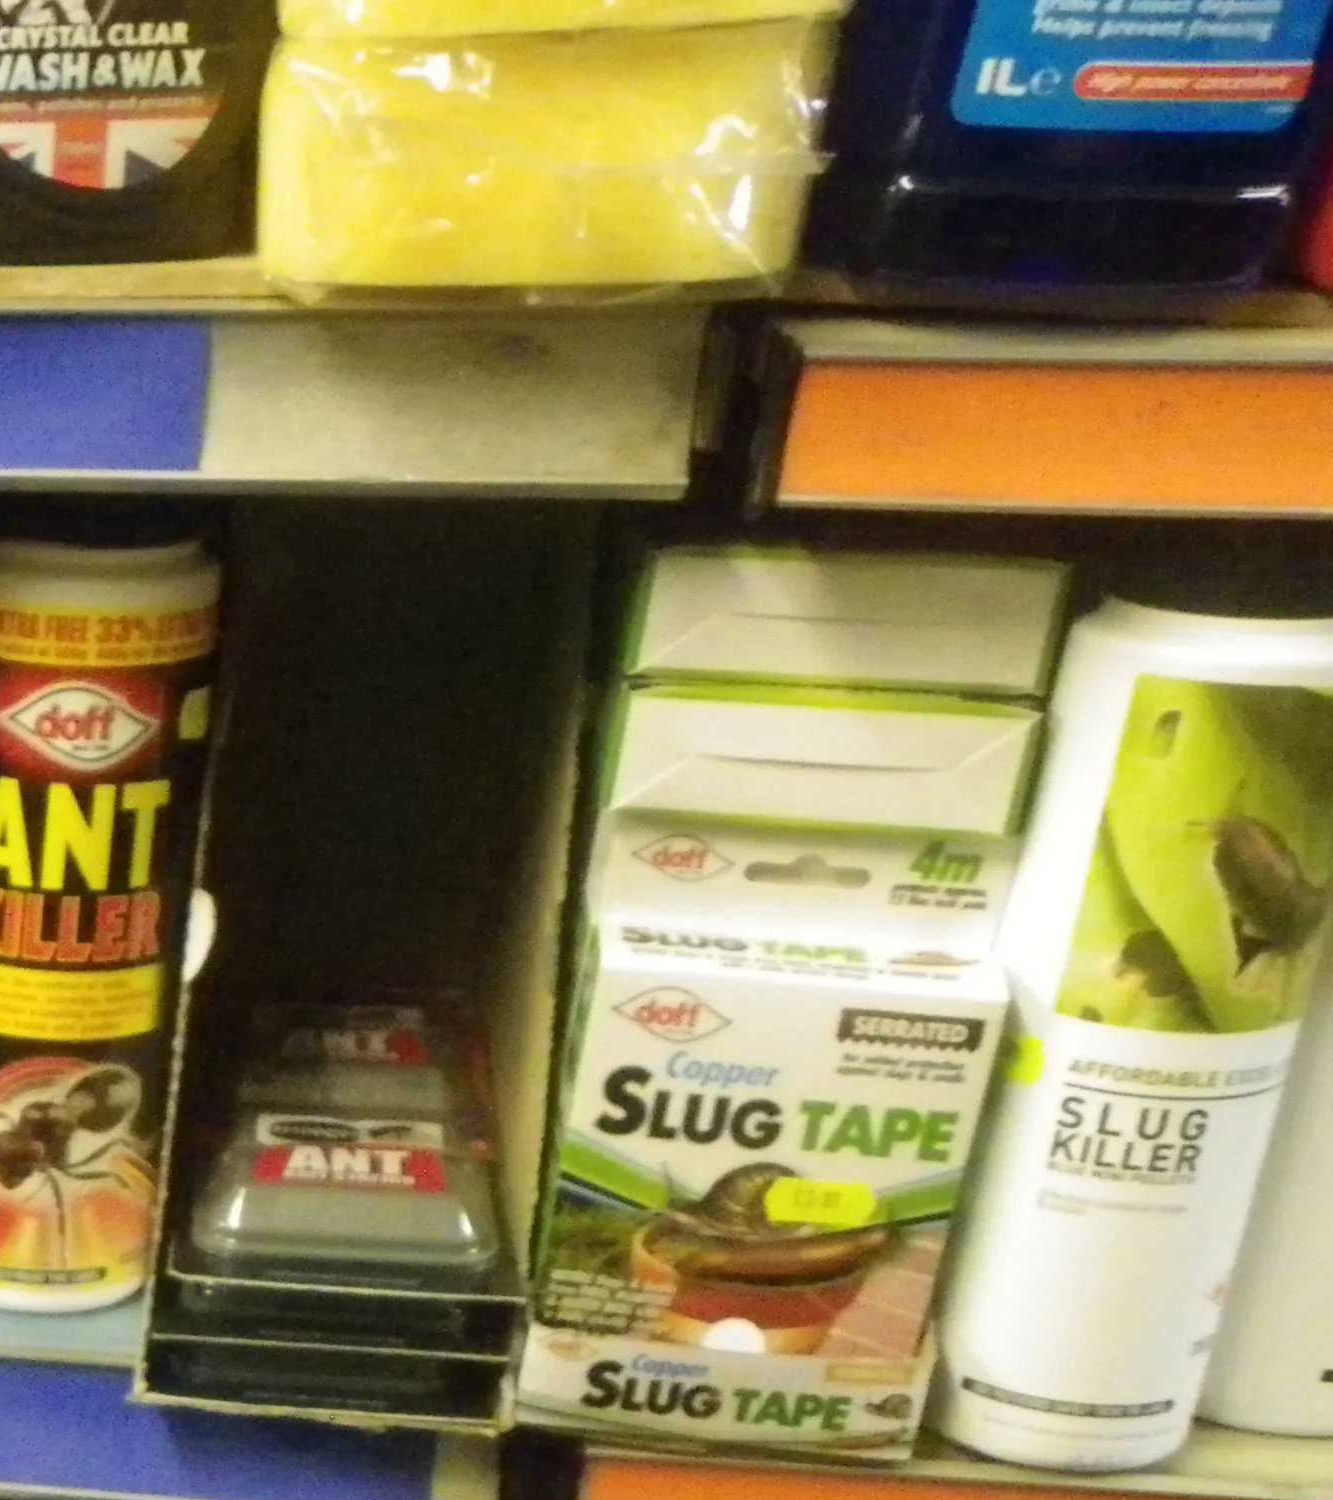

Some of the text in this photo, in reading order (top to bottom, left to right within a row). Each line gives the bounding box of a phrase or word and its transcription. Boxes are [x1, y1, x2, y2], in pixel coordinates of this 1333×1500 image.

[107, 21, 190, 45] CLEAR
[35, 702, 117, 741] doff
[910, 839, 986, 883] 4m
[634, 1000, 701, 1030] doff
[666, 1050, 781, 1090] Copper
[1068, 1059, 1218, 1088] AFFORDABLE
[595, 1065, 960, 1164] SLUG TAPE
[1058, 1096, 1211, 1142] SLUG
[288, 1144, 412, 1176] ANT
[1051, 1130, 1204, 1174] KILLER
[631, 1352, 710, 1379] Copper
[581, 1360, 853, 1432] SLUG TAPE
